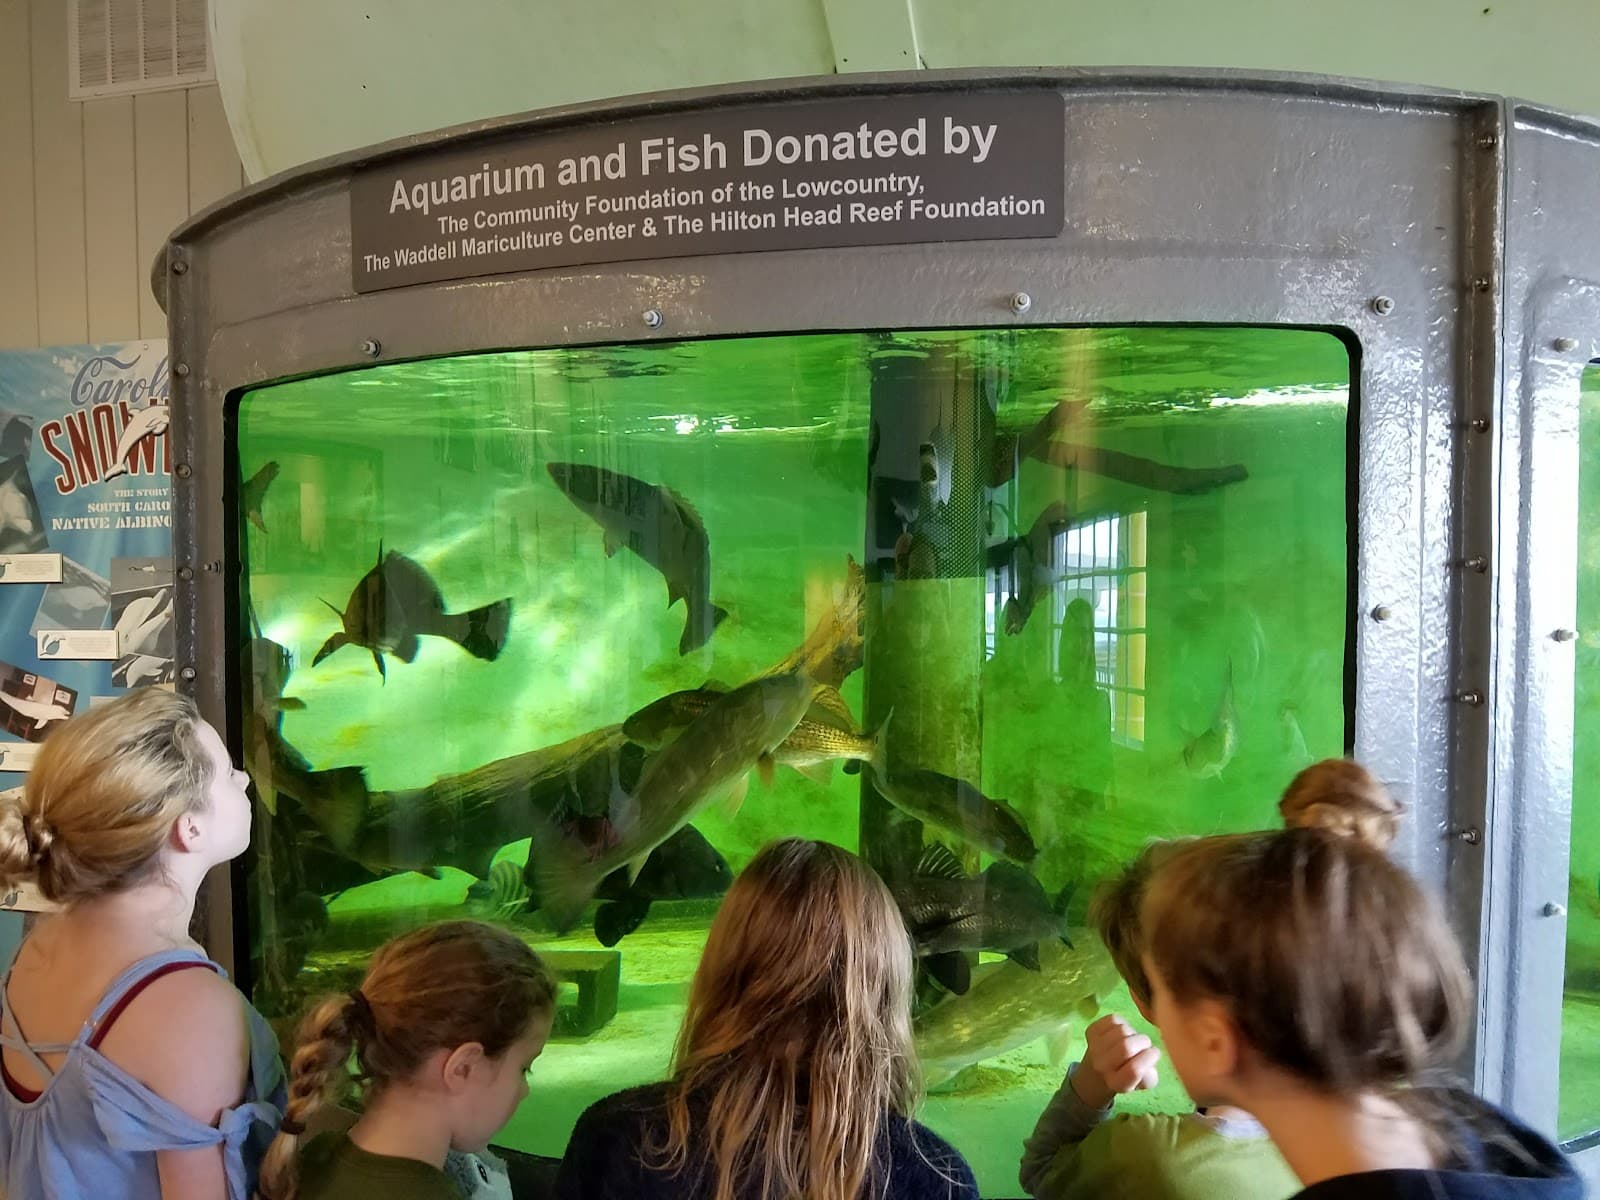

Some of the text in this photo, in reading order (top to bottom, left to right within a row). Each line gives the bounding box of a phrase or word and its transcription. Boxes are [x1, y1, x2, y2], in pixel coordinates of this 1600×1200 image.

[389, 116, 998, 216] Aquarium and Fish Donated by
[364, 196, 1045, 273] The Waddell Mariculture Center & The Hilton Head Reef Foundation
[437, 172, 925, 235] The Community Foundation of the Lowcountry,
[40, 398, 170, 495] SNOW
[52, 517, 110, 530] NATIVE
[87, 502, 131, 513] SOUTH
[114, 487, 169, 497] THE STORY
